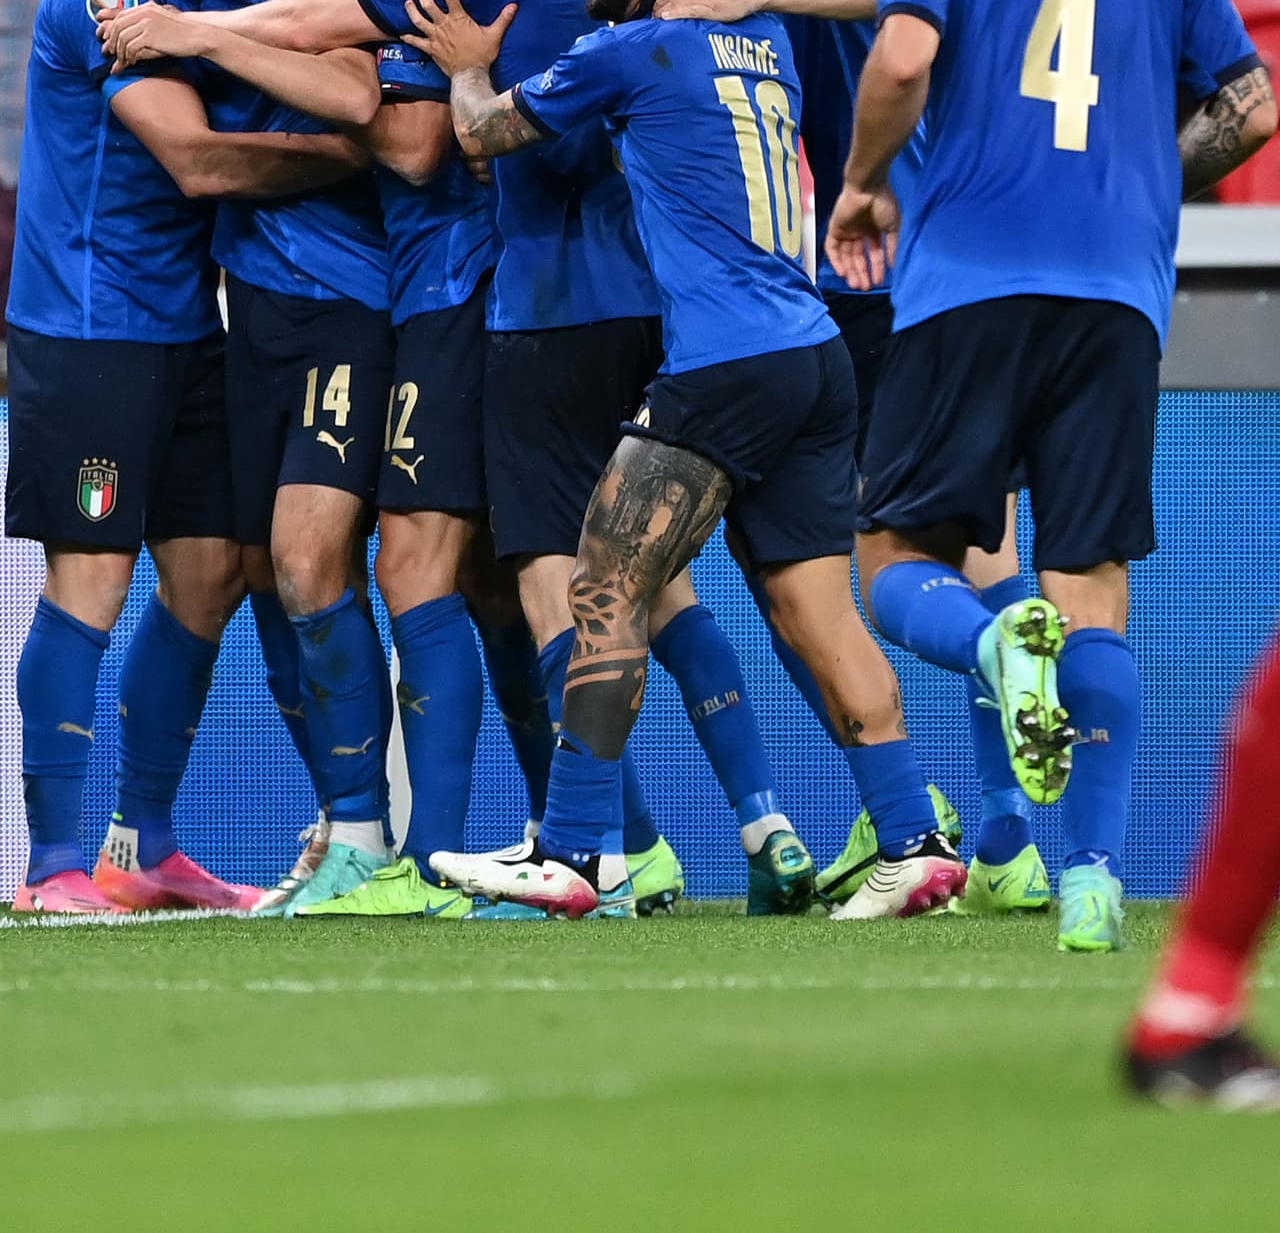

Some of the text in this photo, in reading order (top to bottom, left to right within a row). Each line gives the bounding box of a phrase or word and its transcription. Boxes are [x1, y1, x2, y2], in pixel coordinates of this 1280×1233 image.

[708, 33, 780, 75] INSIGNE
[713, 75, 802, 259] 10
[303, 364, 352, 427] 14
[82, 470, 114, 481] ITALIA
